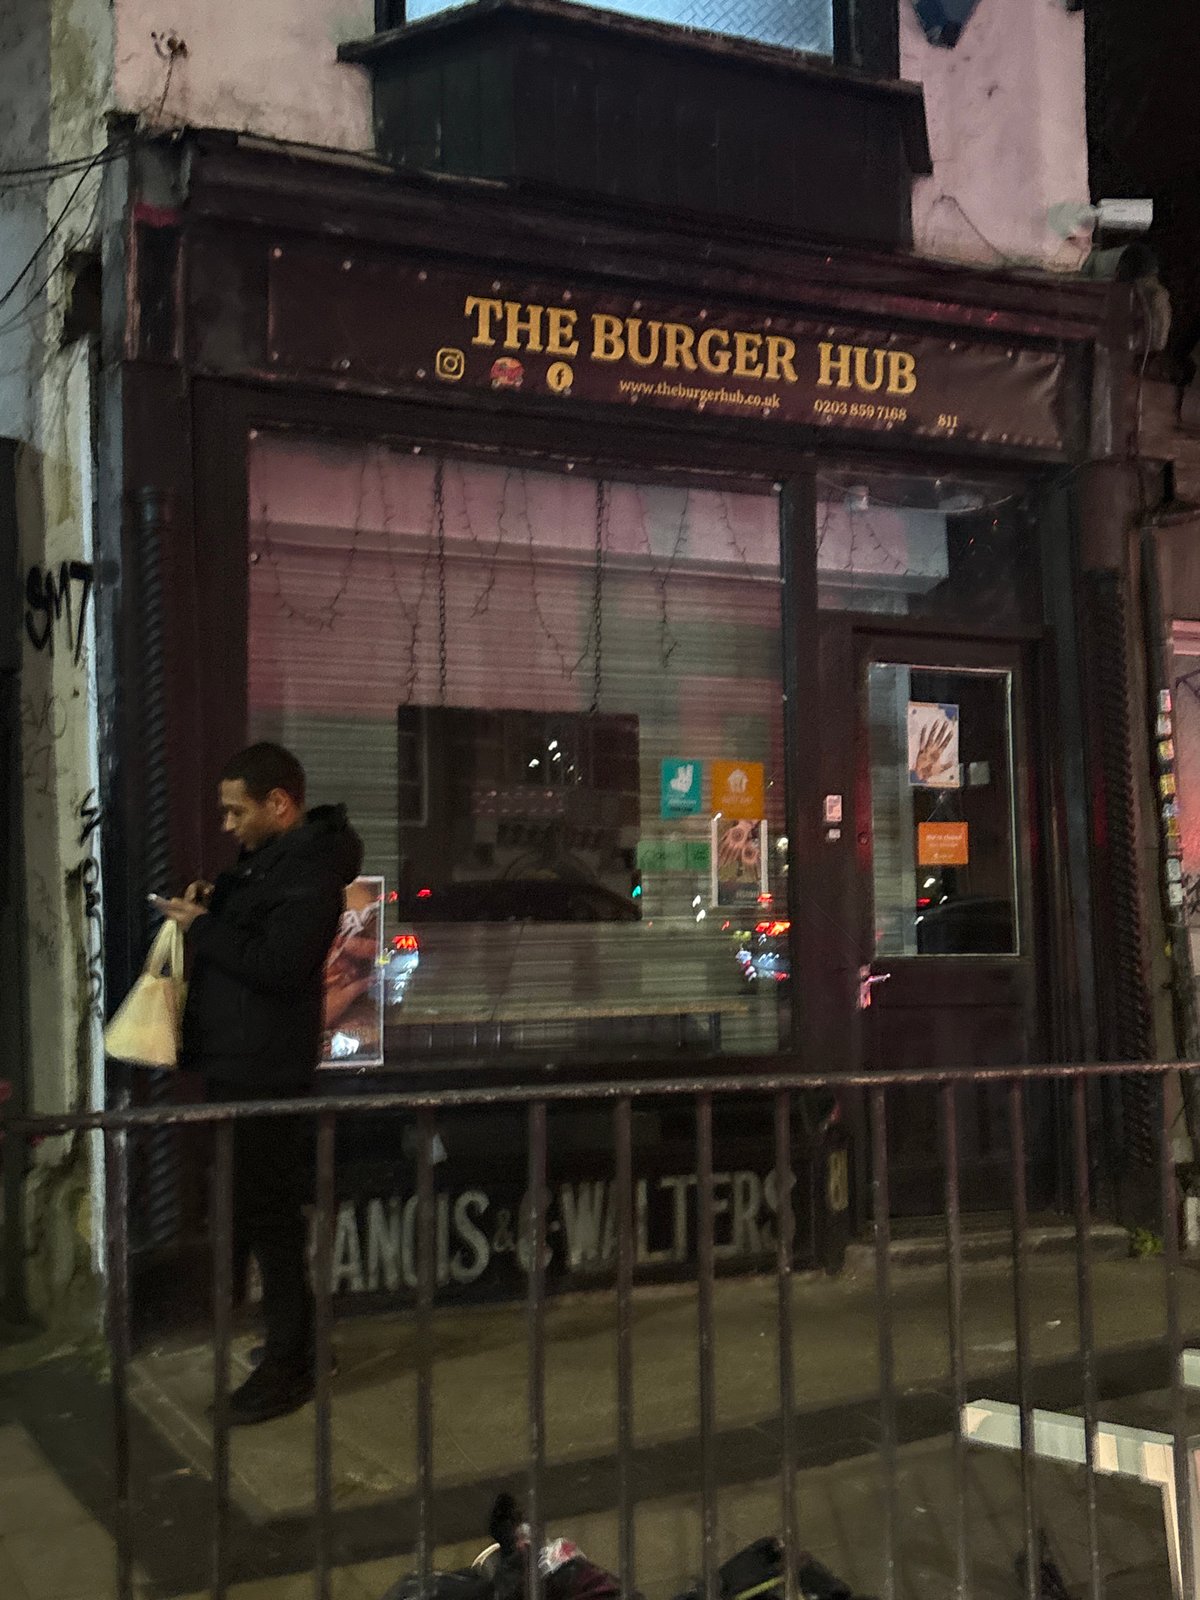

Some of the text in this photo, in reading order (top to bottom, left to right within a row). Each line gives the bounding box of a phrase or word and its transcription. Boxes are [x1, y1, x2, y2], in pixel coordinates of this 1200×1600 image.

[465, 296, 918, 397] THE BURGER HUB
[618, 379, 781, 409] www.theburgerhub.co.uk
[813, 398, 848, 415] 0203
[850, 402, 875, 418] 859
